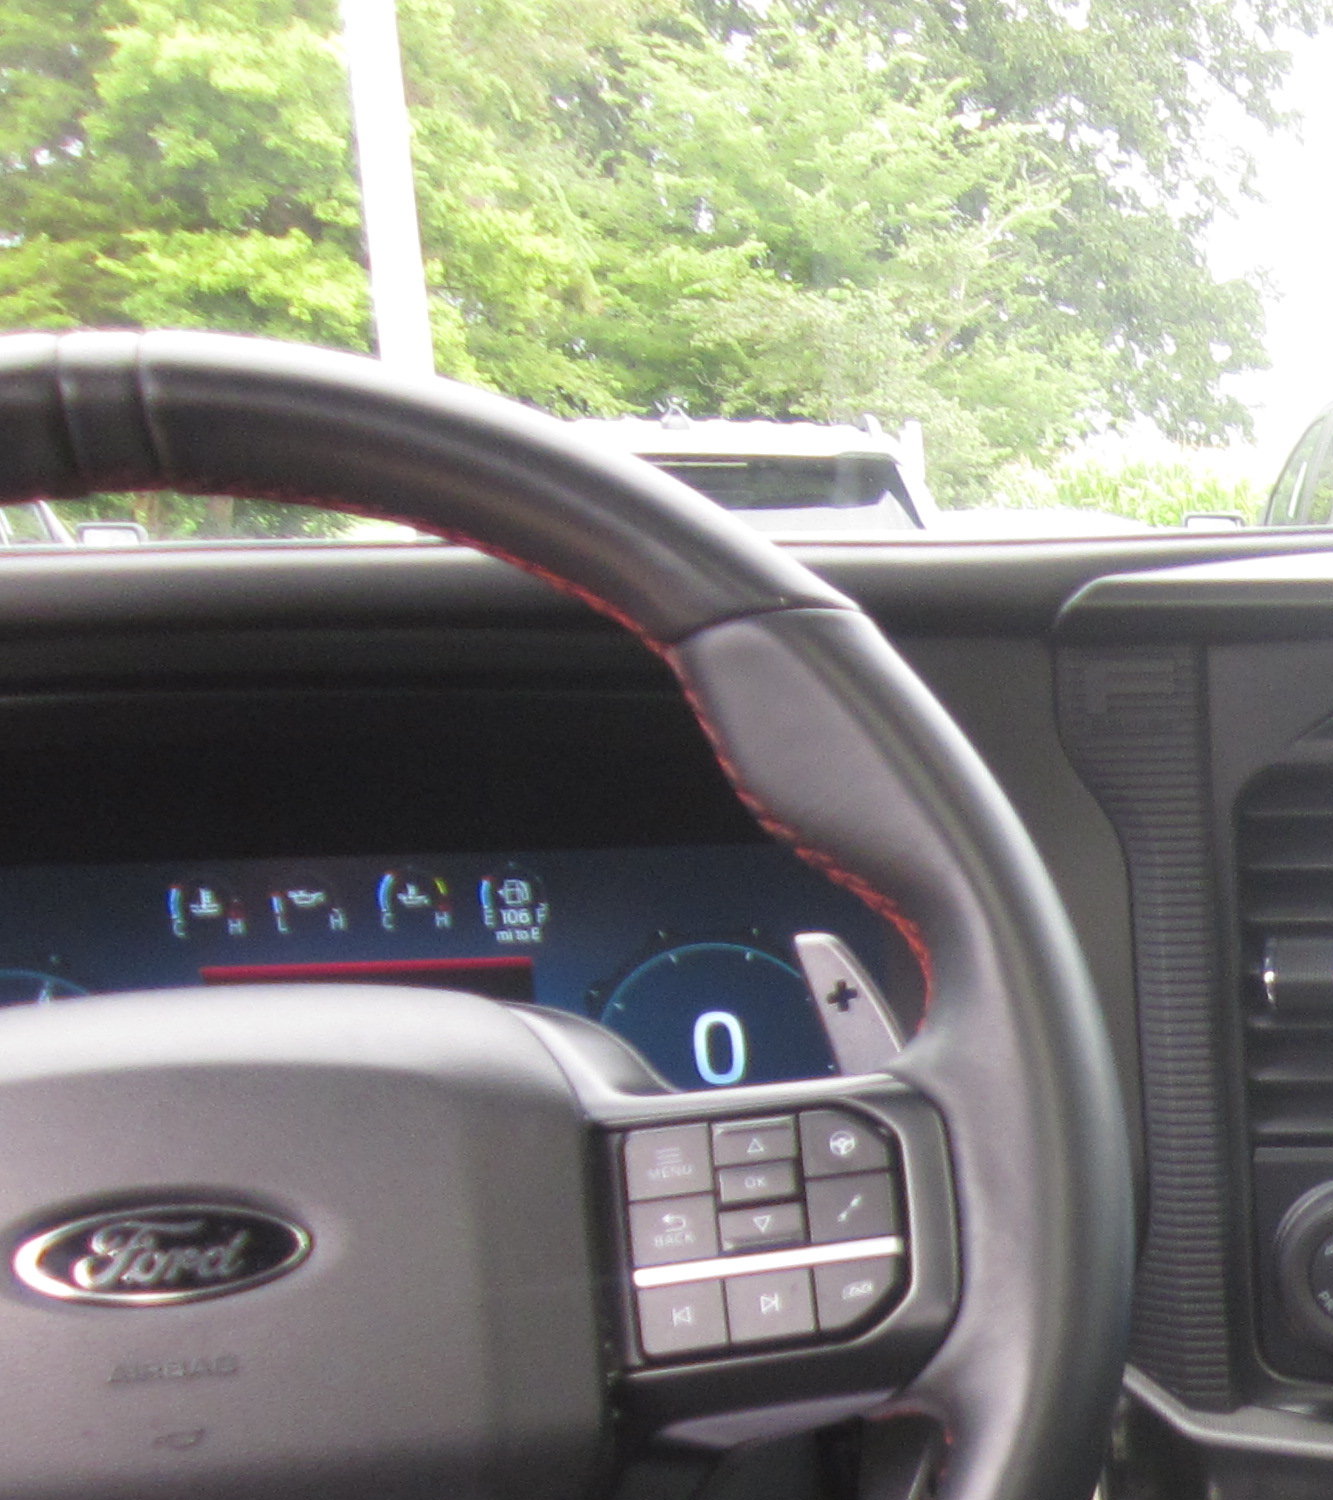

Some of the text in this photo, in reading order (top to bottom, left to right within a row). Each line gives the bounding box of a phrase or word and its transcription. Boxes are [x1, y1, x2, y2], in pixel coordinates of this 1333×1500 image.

[500, 909, 530, 925] 106
[693, 1011, 746, 1085] 0
[647, 1164, 692, 1180] MENU
[744, 1175, 767, 1189] OK
[73, 1219, 249, 1291] Ford
